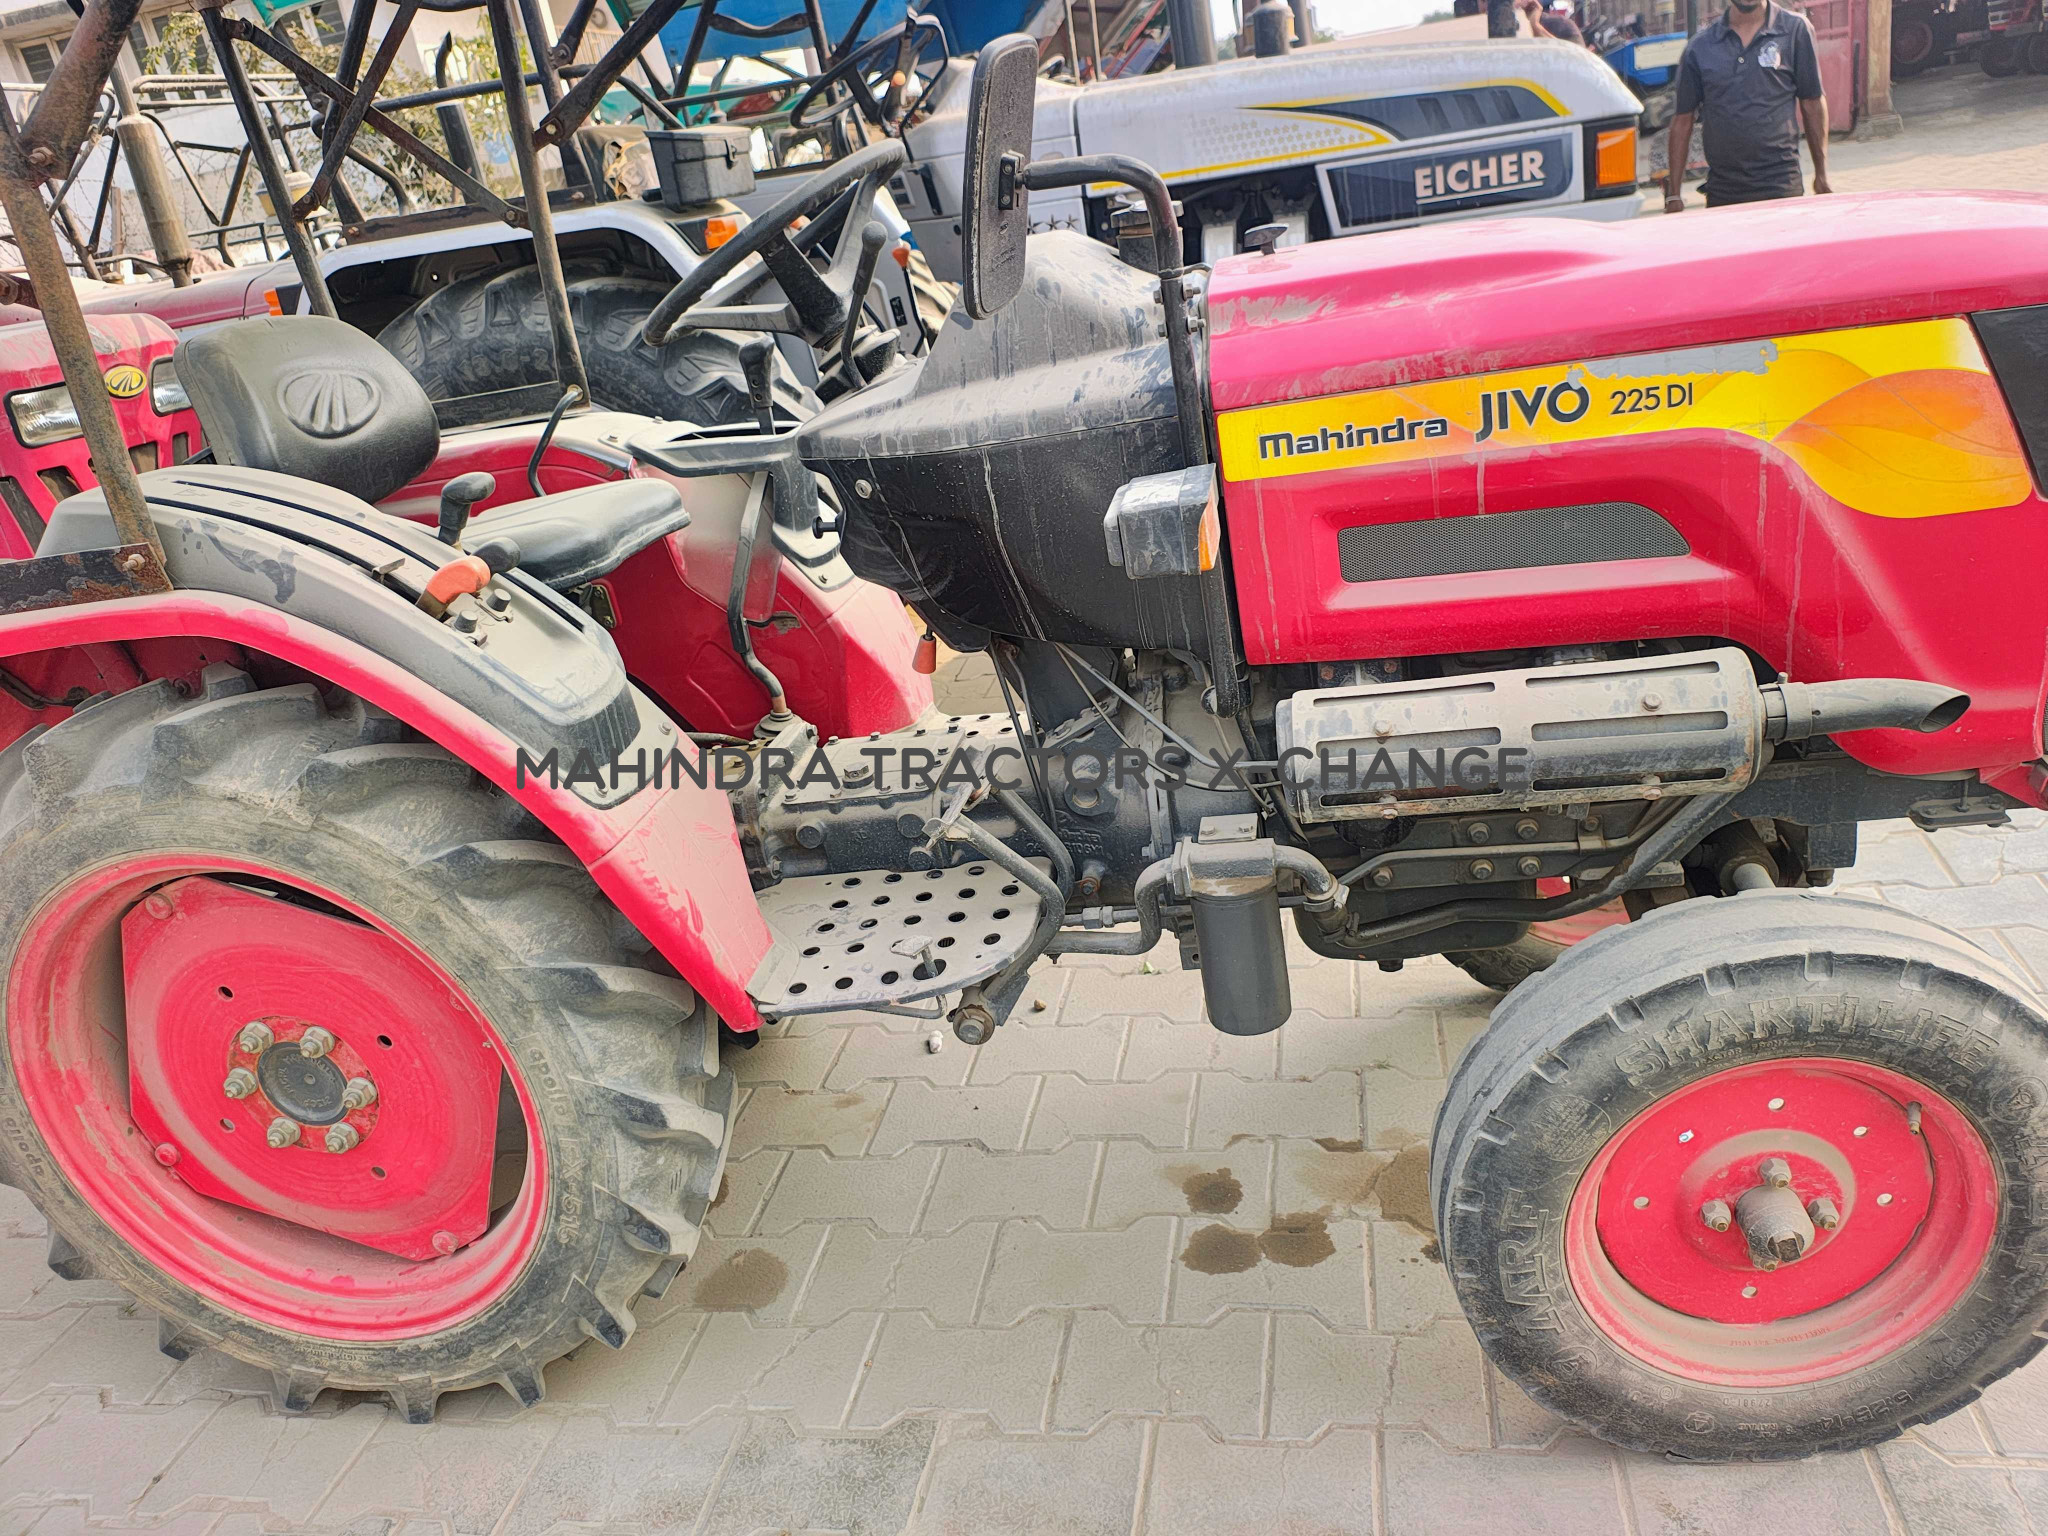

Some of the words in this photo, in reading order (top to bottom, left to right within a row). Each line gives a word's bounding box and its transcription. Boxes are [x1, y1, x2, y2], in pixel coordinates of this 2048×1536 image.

[1414, 150, 1547, 199] EICHER
[1258, 415, 1449, 460] Mahindra
[1475, 380, 1591, 443] JIVO
[1609, 387, 1661, 416] 225
[1667, 382, 1695, 408] DI
[528, 1047, 569, 1117] apollo
[2, 1116, 46, 1177] apollo
[1498, 1187, 1566, 1337] MRF
[1820, 1389, 1914, 1431] 5.25-14
